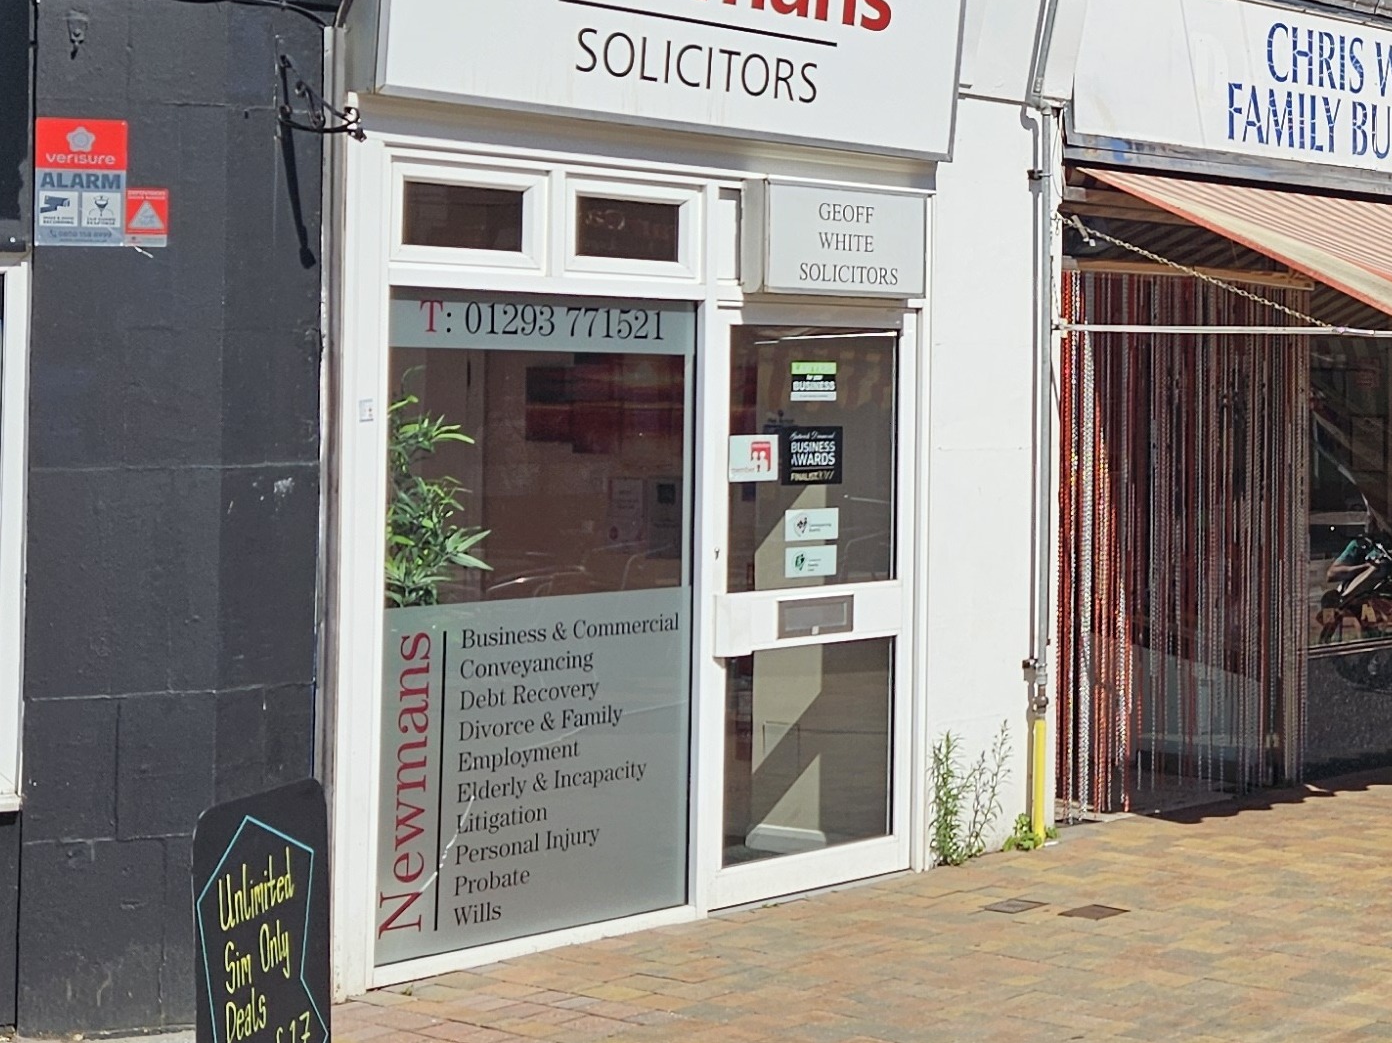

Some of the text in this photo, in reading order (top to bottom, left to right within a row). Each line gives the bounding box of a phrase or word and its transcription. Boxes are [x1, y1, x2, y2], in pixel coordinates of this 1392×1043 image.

[576, 28, 818, 103] SOLICITORS
[1267, 22, 1364, 94] CHRIS
[1228, 82, 1341, 154] FAMILY
[46, 153, 115, 165] verisure
[40, 172, 121, 189] ALARM
[818, 202, 875, 225] GEOFF
[818, 231, 875, 254] WHITE
[799, 262, 899, 287] SOLICITORS
[420, 300, 664, 340] T: 01293 771521
[792, 381, 836, 391] BUSINESS
[791, 441, 836, 453] BUSINESS
[791, 452, 836, 466] AWARDS
[461, 613, 679, 649] Business & Commercial
[460, 651, 594, 679] Conveyancing
[459, 680, 600, 711] Debt Recovery
[459, 705, 623, 742] Divorce & Family
[457, 739, 580, 773] Employment
[378, 631, 431, 940] Newmans
[457, 760, 647, 804] Elderly & Incapacity
[457, 805, 547, 835] Litigation
[455, 826, 600, 865] Personal Injury
[218, 845, 295, 931] Unlimited
[454, 868, 530, 896] Probate
[453, 903, 502, 926] Wills
[224, 919, 291, 994] Sim Only
[225, 987, 267, 1043] Deals
